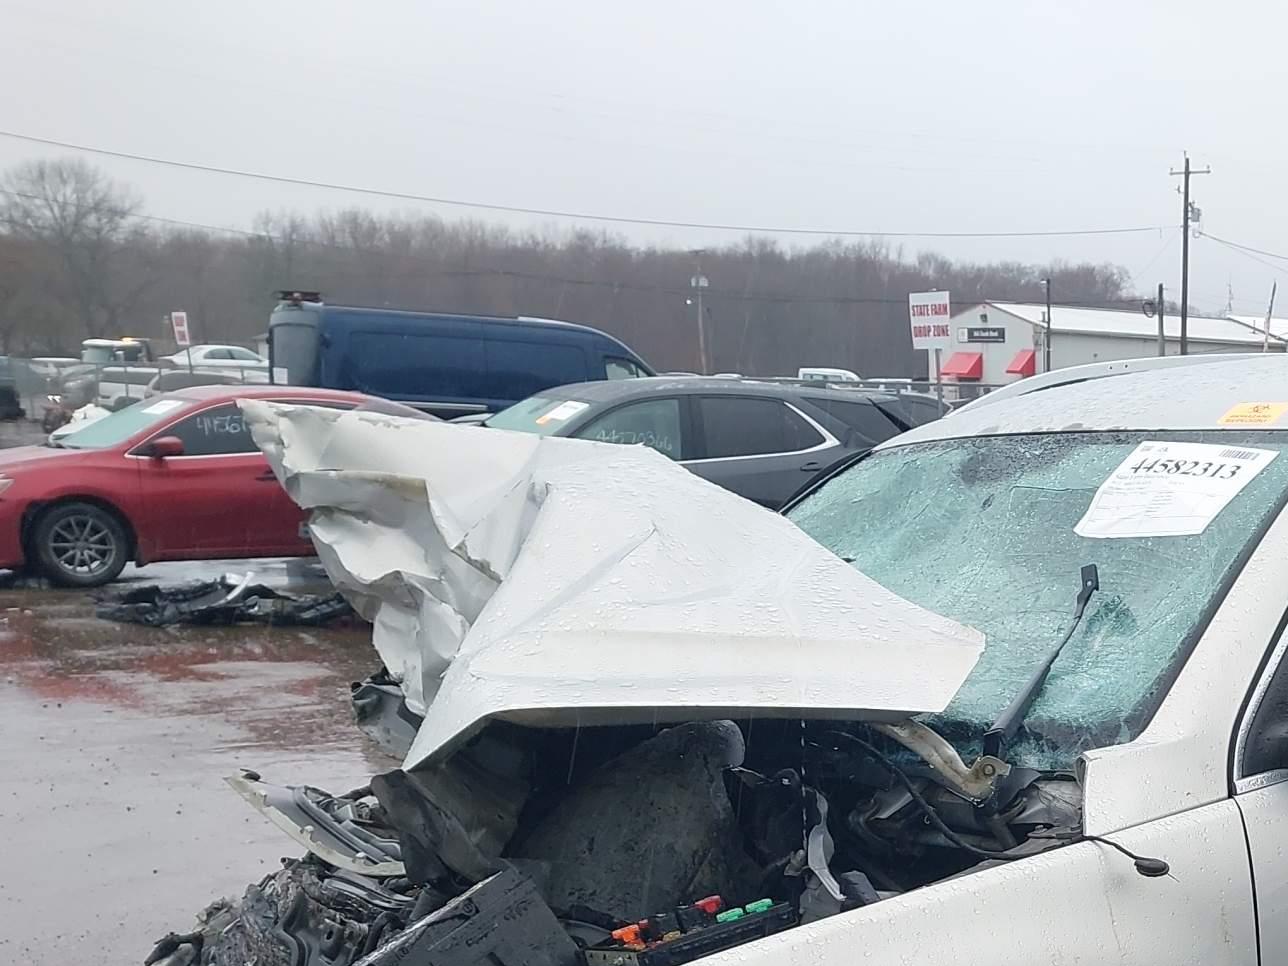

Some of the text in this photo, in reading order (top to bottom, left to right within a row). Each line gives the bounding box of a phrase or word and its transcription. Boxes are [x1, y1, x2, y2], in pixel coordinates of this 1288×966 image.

[912, 303, 948, 317] STATE FARM
[913, 325, 931, 338] DROP
[932, 324, 950, 337] ZONE
[1131, 457, 1241, 480] 44582313
